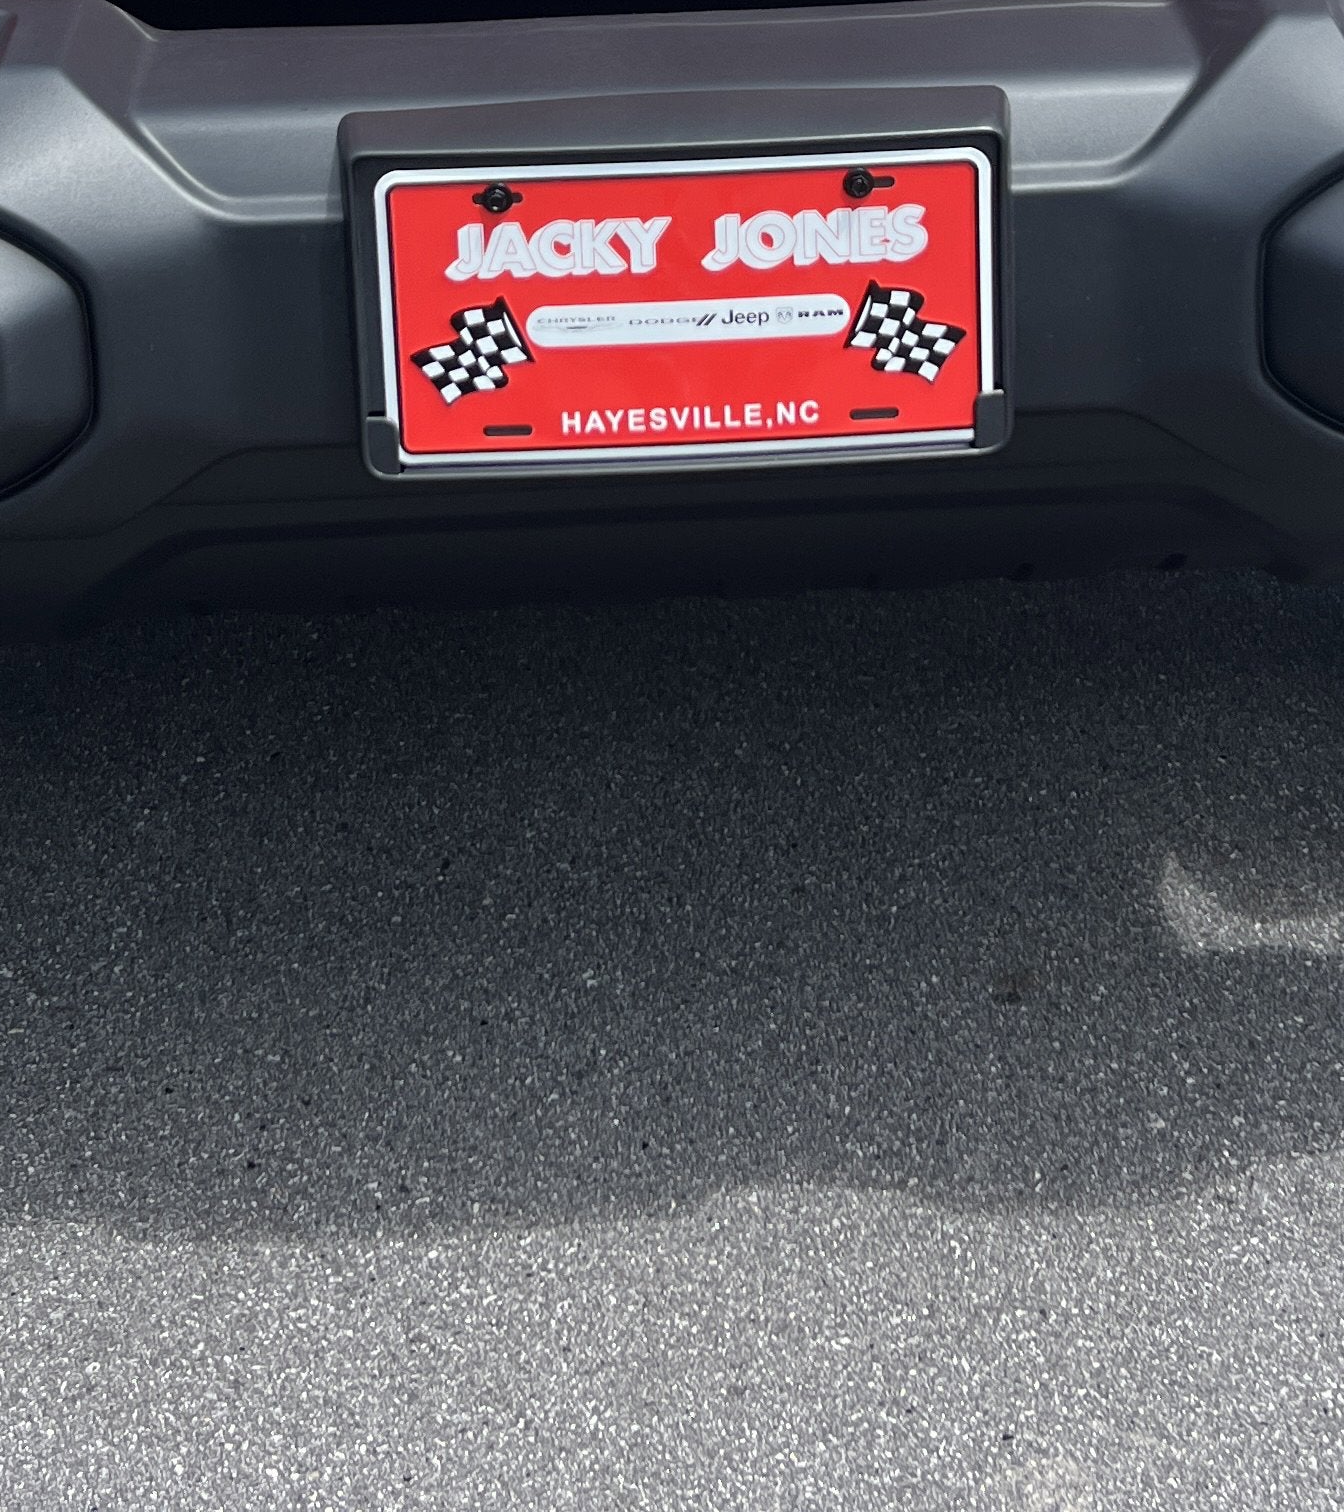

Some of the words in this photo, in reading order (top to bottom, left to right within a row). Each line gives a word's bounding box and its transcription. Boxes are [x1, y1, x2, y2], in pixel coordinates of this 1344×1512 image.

[445, 215, 672, 281] JACKY
[701, 204, 929, 272] JONES
[537, 316, 616, 324] CHRYSLER
[721, 308, 770, 326] Jeep
[797, 308, 844, 318] RAM
